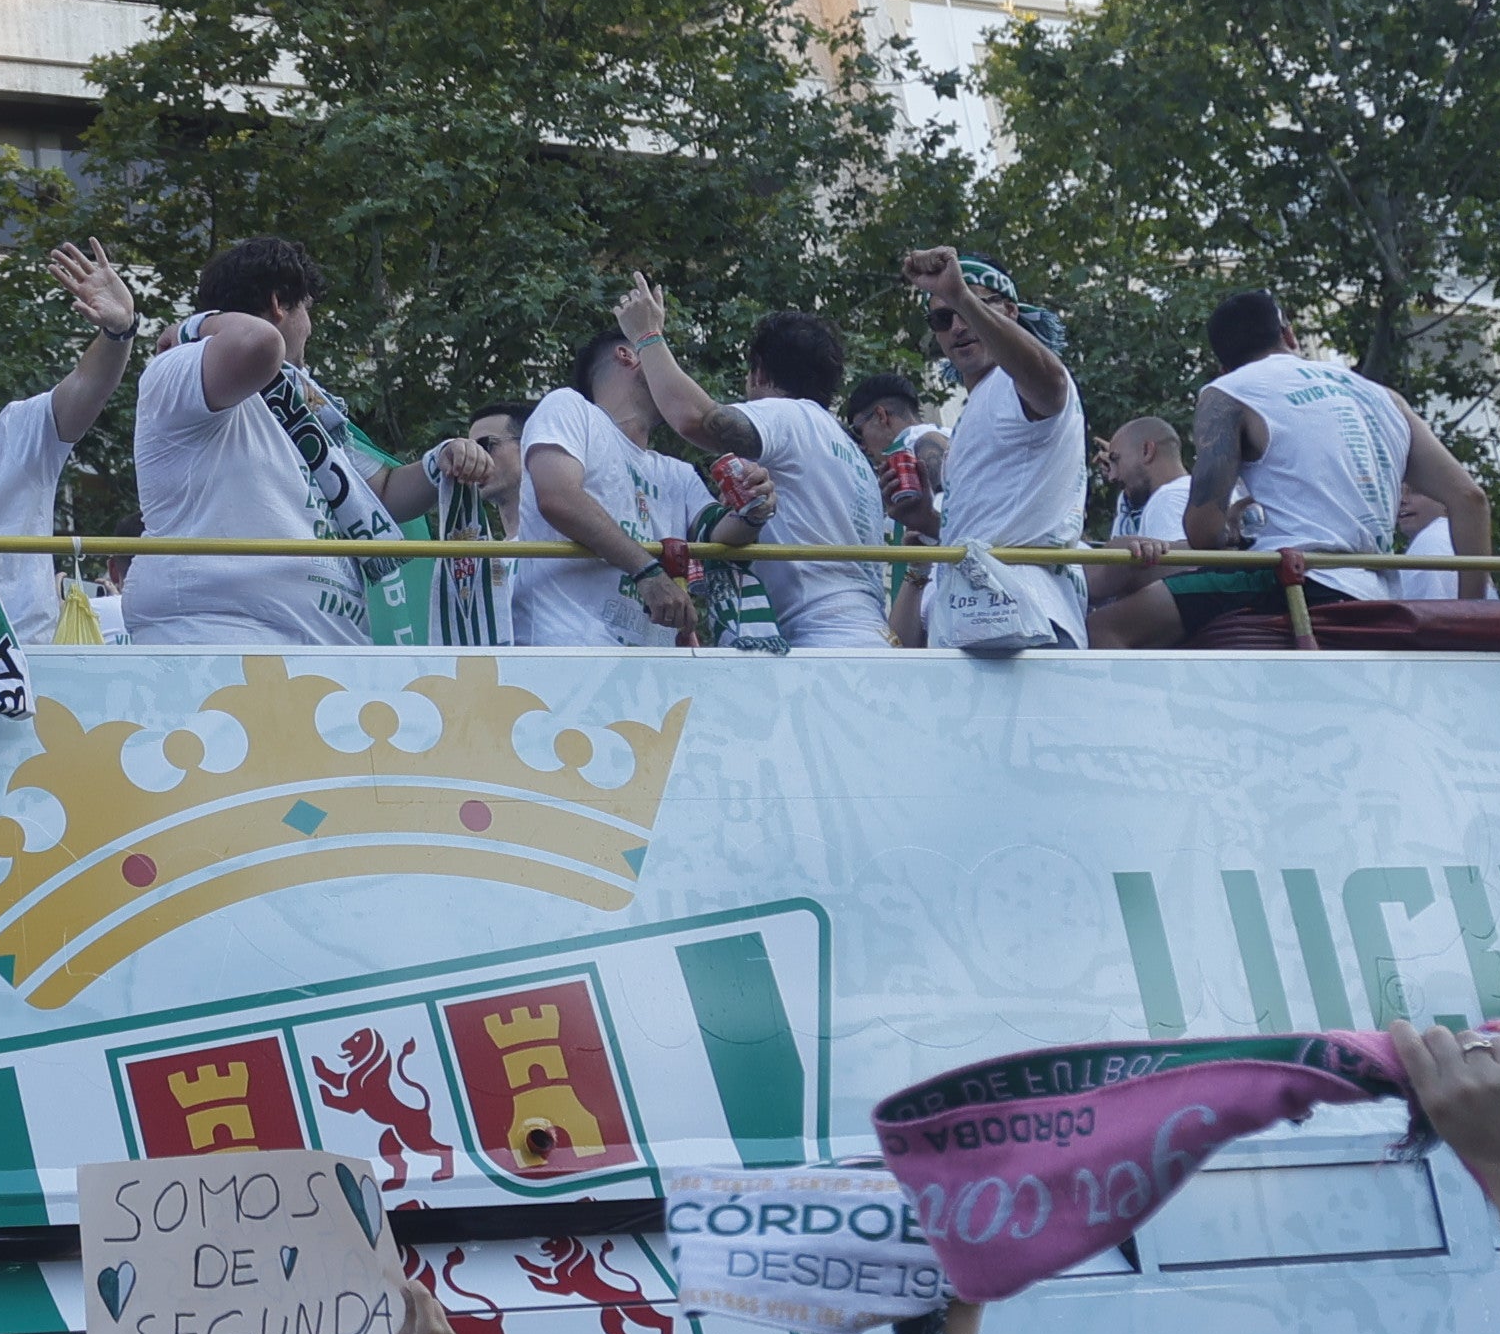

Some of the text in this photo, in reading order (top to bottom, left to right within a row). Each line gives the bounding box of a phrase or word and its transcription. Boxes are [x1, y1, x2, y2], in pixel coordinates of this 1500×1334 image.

[103, 1170, 327, 1243] SOMOS
[192, 1243, 259, 1289] DE
[727, 1249, 881, 1295] DESDE
